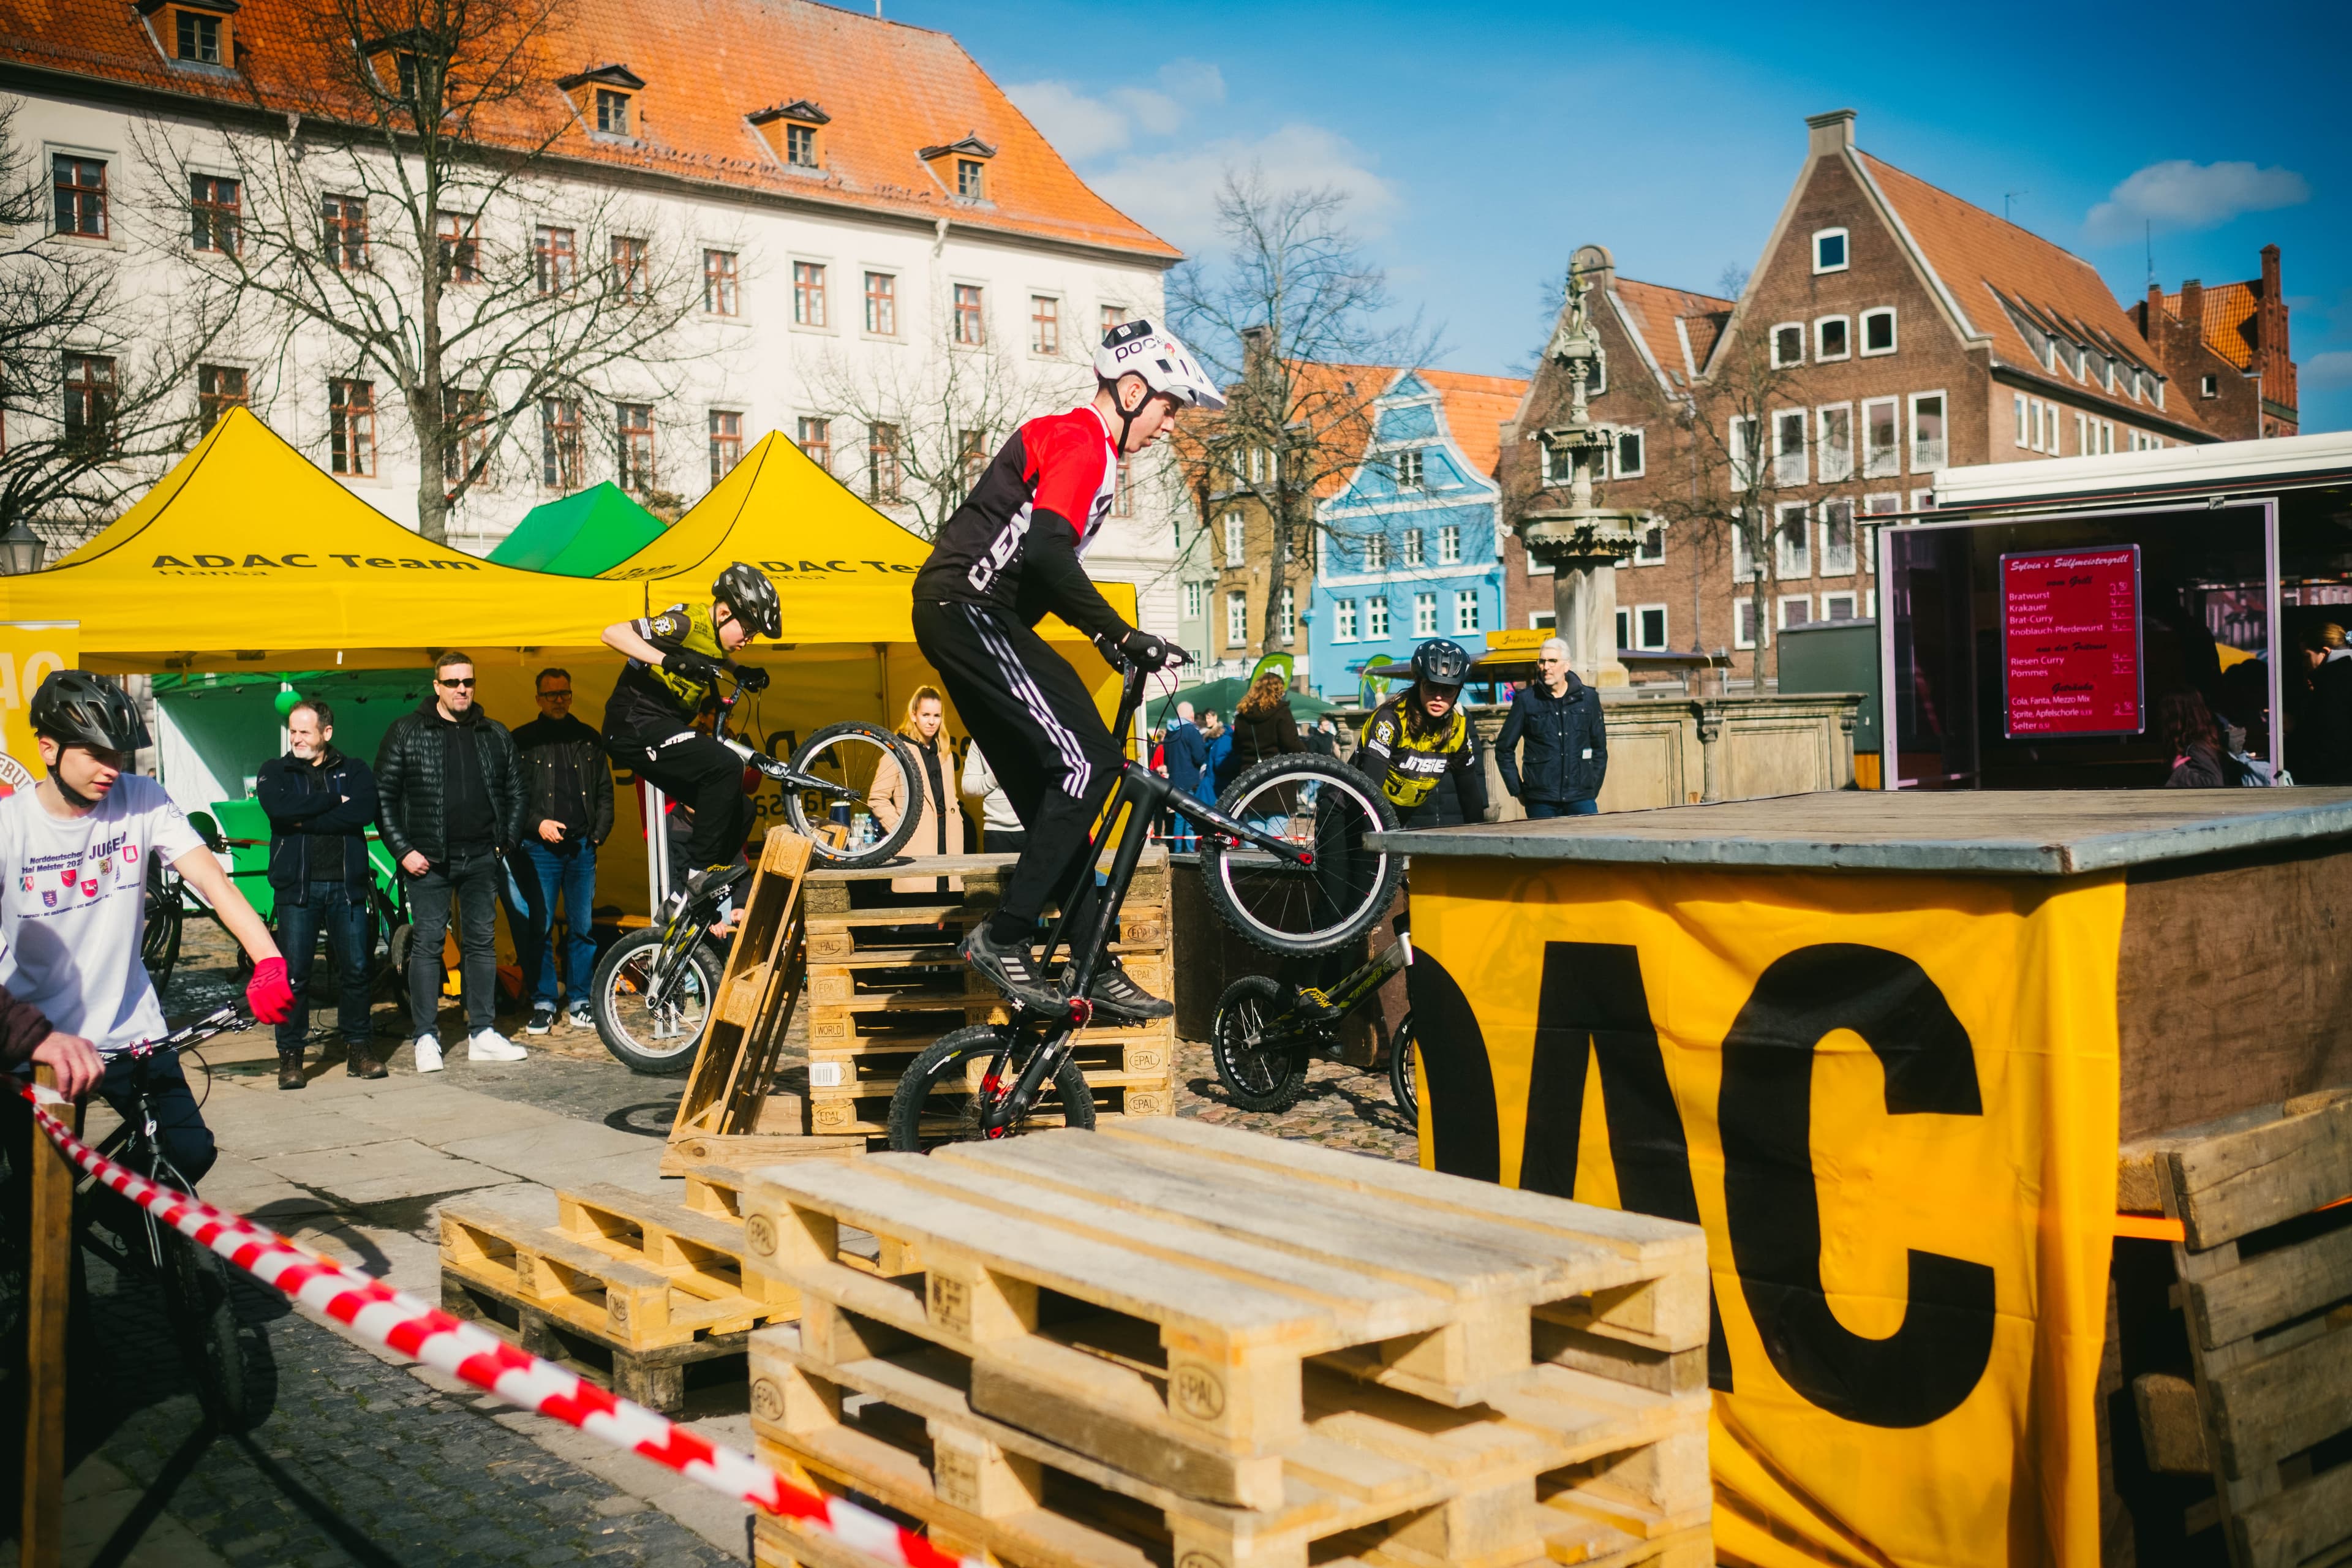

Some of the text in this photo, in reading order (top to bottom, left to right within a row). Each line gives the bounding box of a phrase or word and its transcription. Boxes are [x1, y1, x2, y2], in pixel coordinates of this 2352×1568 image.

[152, 554, 481, 570] ADAC Team
[2069, 576, 2094, 588] Grill
[2009, 592, 2050, 601] Bratwurst
[2009, 603, 2047, 612] Krakauer
[2010, 615, 2053, 625] Brat-Curry
[2010, 624, 2103, 636] Knoblauch-Pferdewurst
[2011, 657, 2039, 666] Riesen
[2041, 656, 2065, 666] Curry
[2011, 669, 2048, 677] Pommes
[2052, 682, 2094, 695] Getränke
[2036, 708, 2079, 718] Apfelschorle
[2013, 722, 2037, 730] Selter
[30, 851, 84, 864] Norddeutscher
[37, 863, 64, 873] Meister
[1132, 927, 1153, 938] EPAL
[1132, 969, 1153, 980] EPAL
[1134, 1055, 1156, 1066] EPAL
[1133, 1098, 1155, 1110] EPAL
[820, 1111, 842, 1122] EPAL
